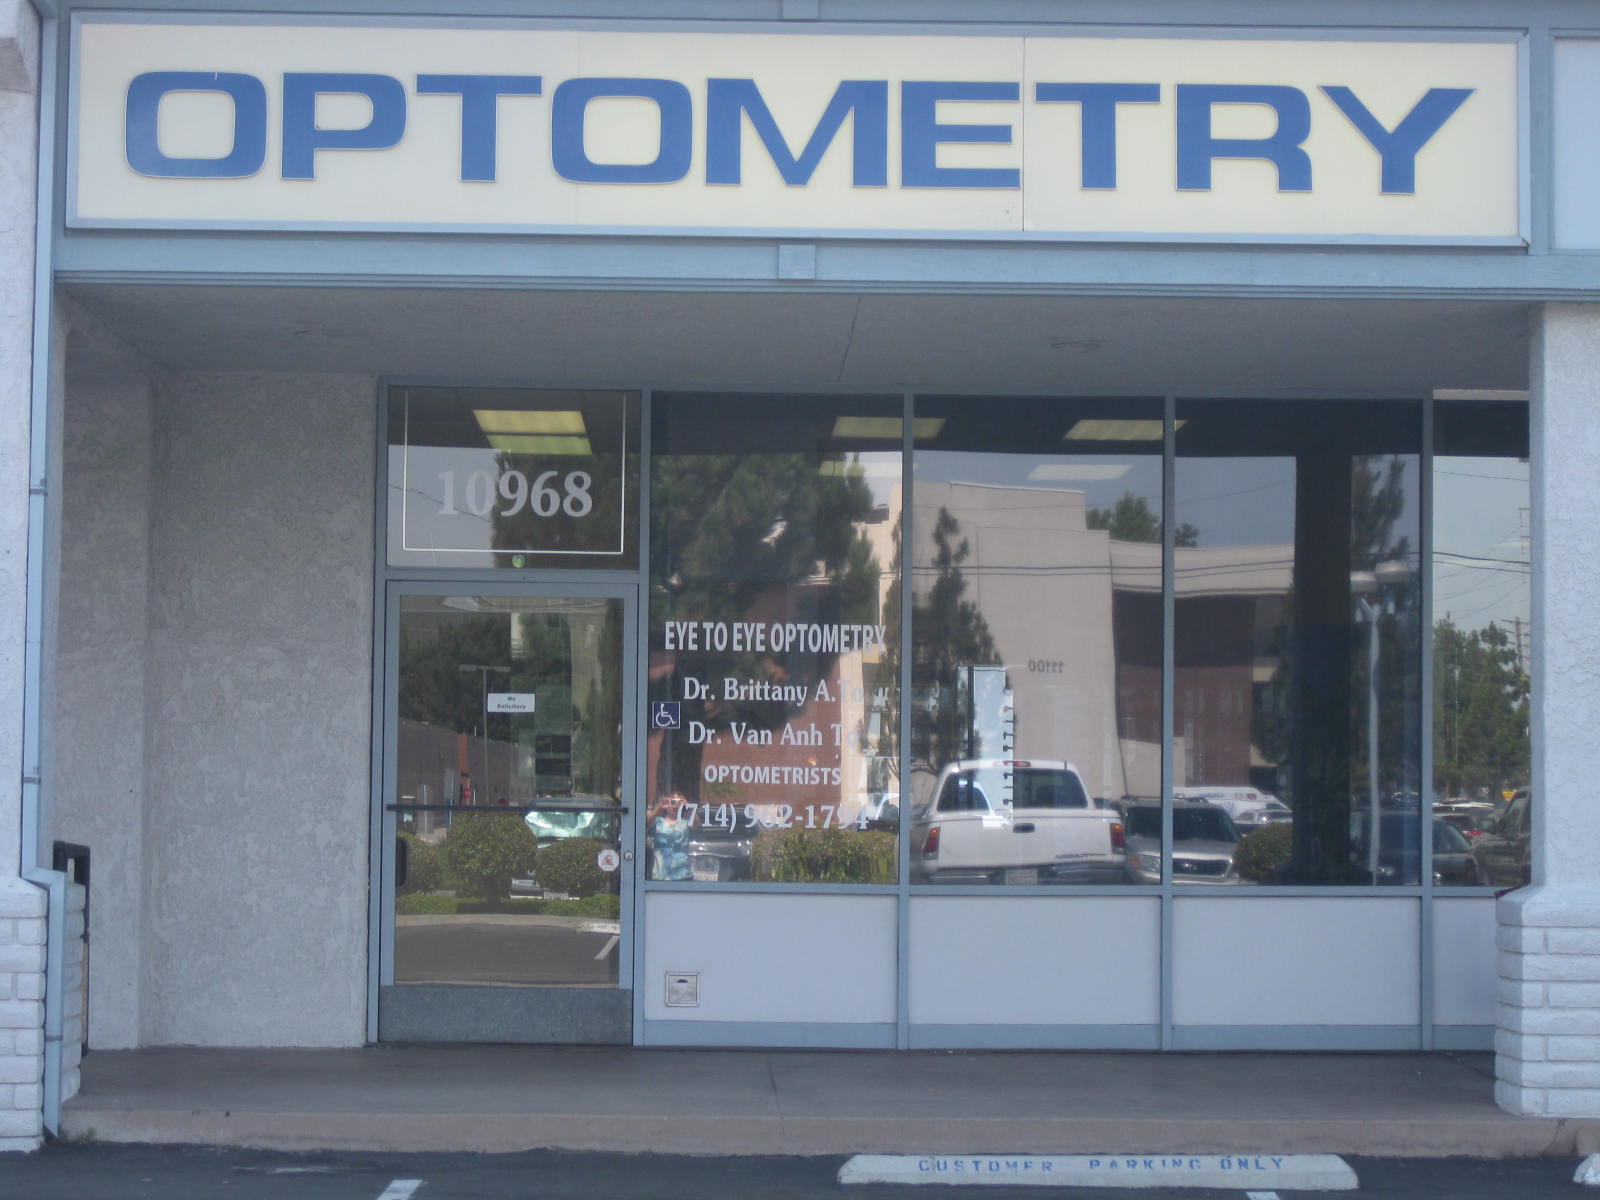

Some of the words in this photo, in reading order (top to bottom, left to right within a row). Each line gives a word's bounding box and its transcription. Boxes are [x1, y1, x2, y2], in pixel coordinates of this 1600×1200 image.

[125, 71, 1476, 195] OPTOMETRY
[437, 470, 593, 517] 10968
[665, 621, 698, 650] EYE
[702, 622, 727, 651] TO
[733, 623, 766, 652] EYE
[770, 623, 887, 653] OPTOMETRY
[684, 677, 715, 701] Dr.
[724, 678, 808, 707] Brittany
[815, 679, 836, 702] A.
[689, 721, 721, 745] Dr.
[731, 722, 773, 745] Van
[780, 723, 823, 746] Anh
[704, 765, 841, 785] OPTOMETRISTS
[676, 803, 737, 833] (714)
[744, 804, 869, 830] 962-1794
[918, 1158, 1053, 1172] CUSTOMER
[1089, 1158, 1201, 1171] PARKING
[1220, 1157, 1283, 1170] ONLY
